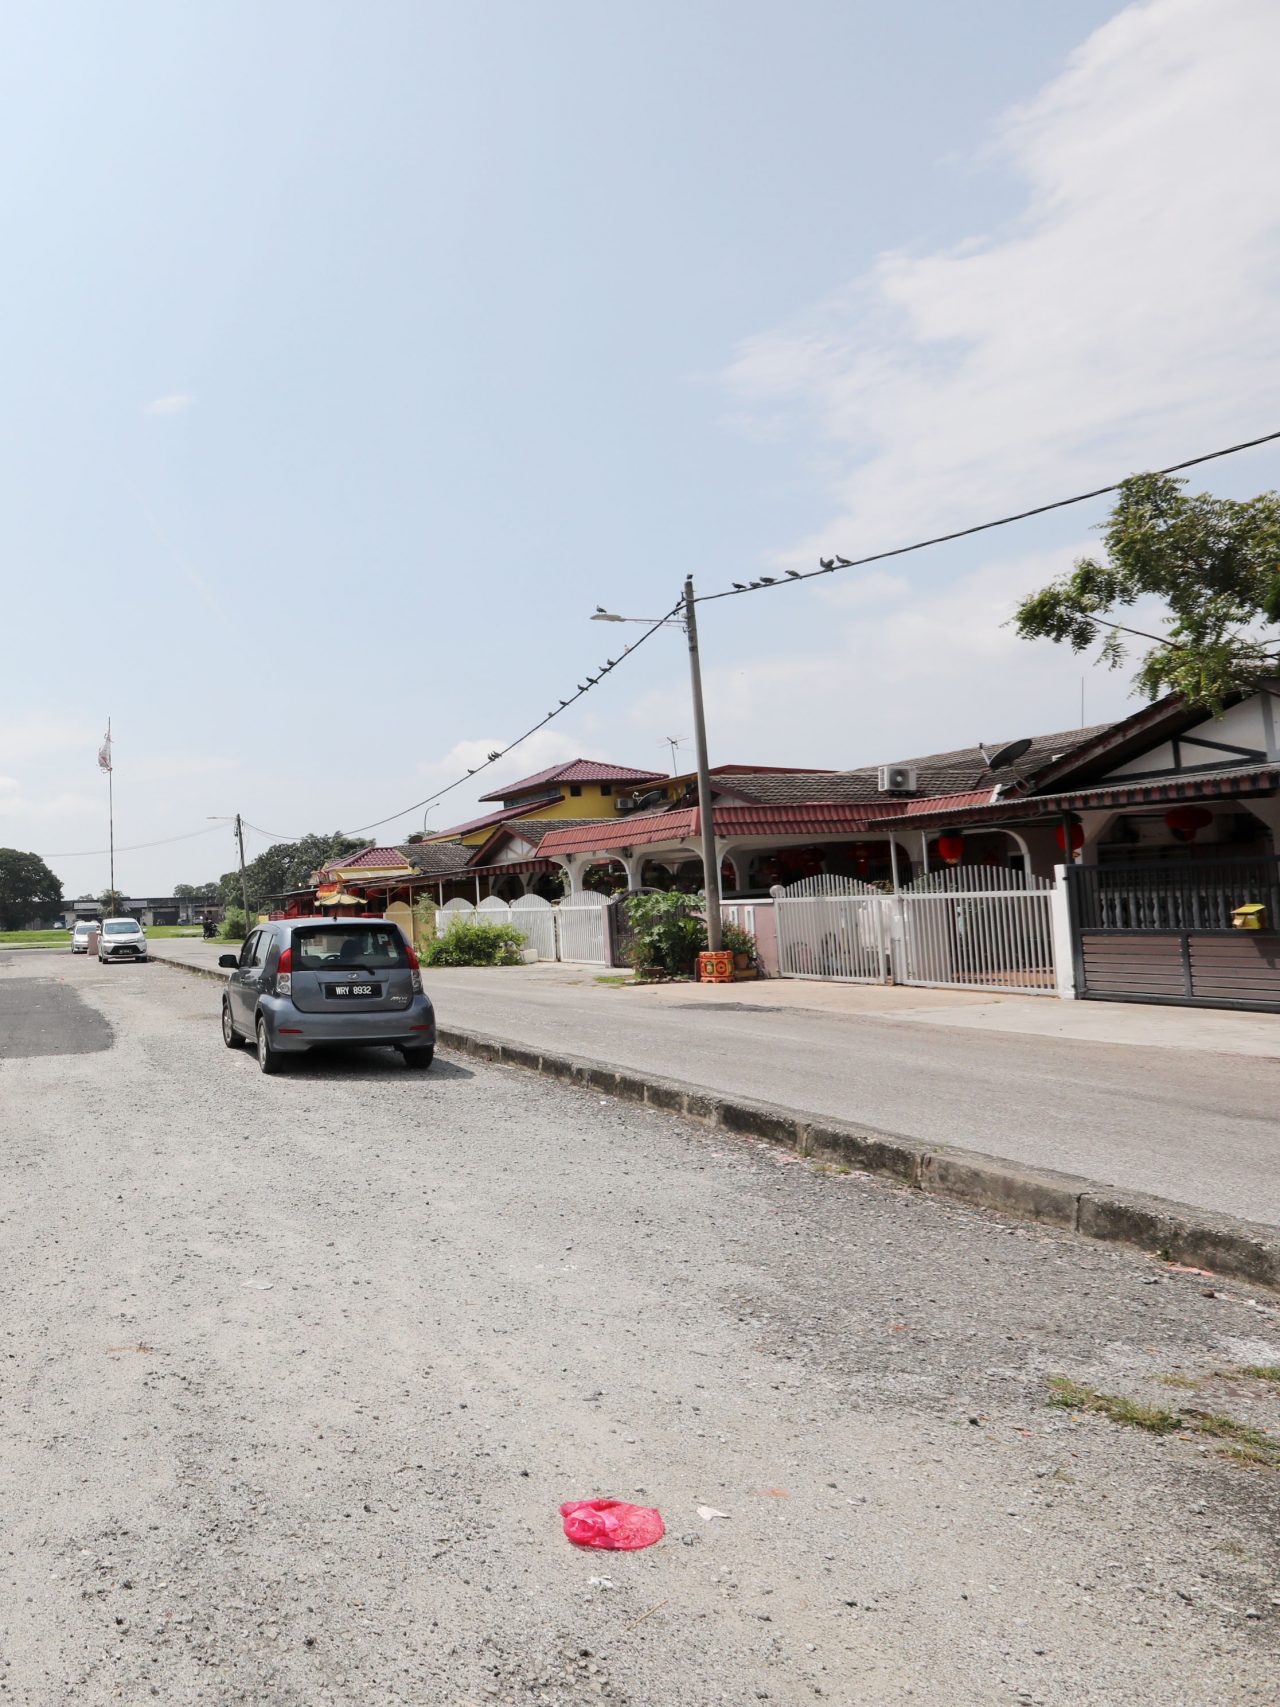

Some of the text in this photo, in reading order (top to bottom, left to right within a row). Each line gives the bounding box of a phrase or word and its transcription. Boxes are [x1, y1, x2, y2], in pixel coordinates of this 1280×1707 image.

[377, 934, 389, 944] P
[335, 985, 372, 995] WRY 8932
